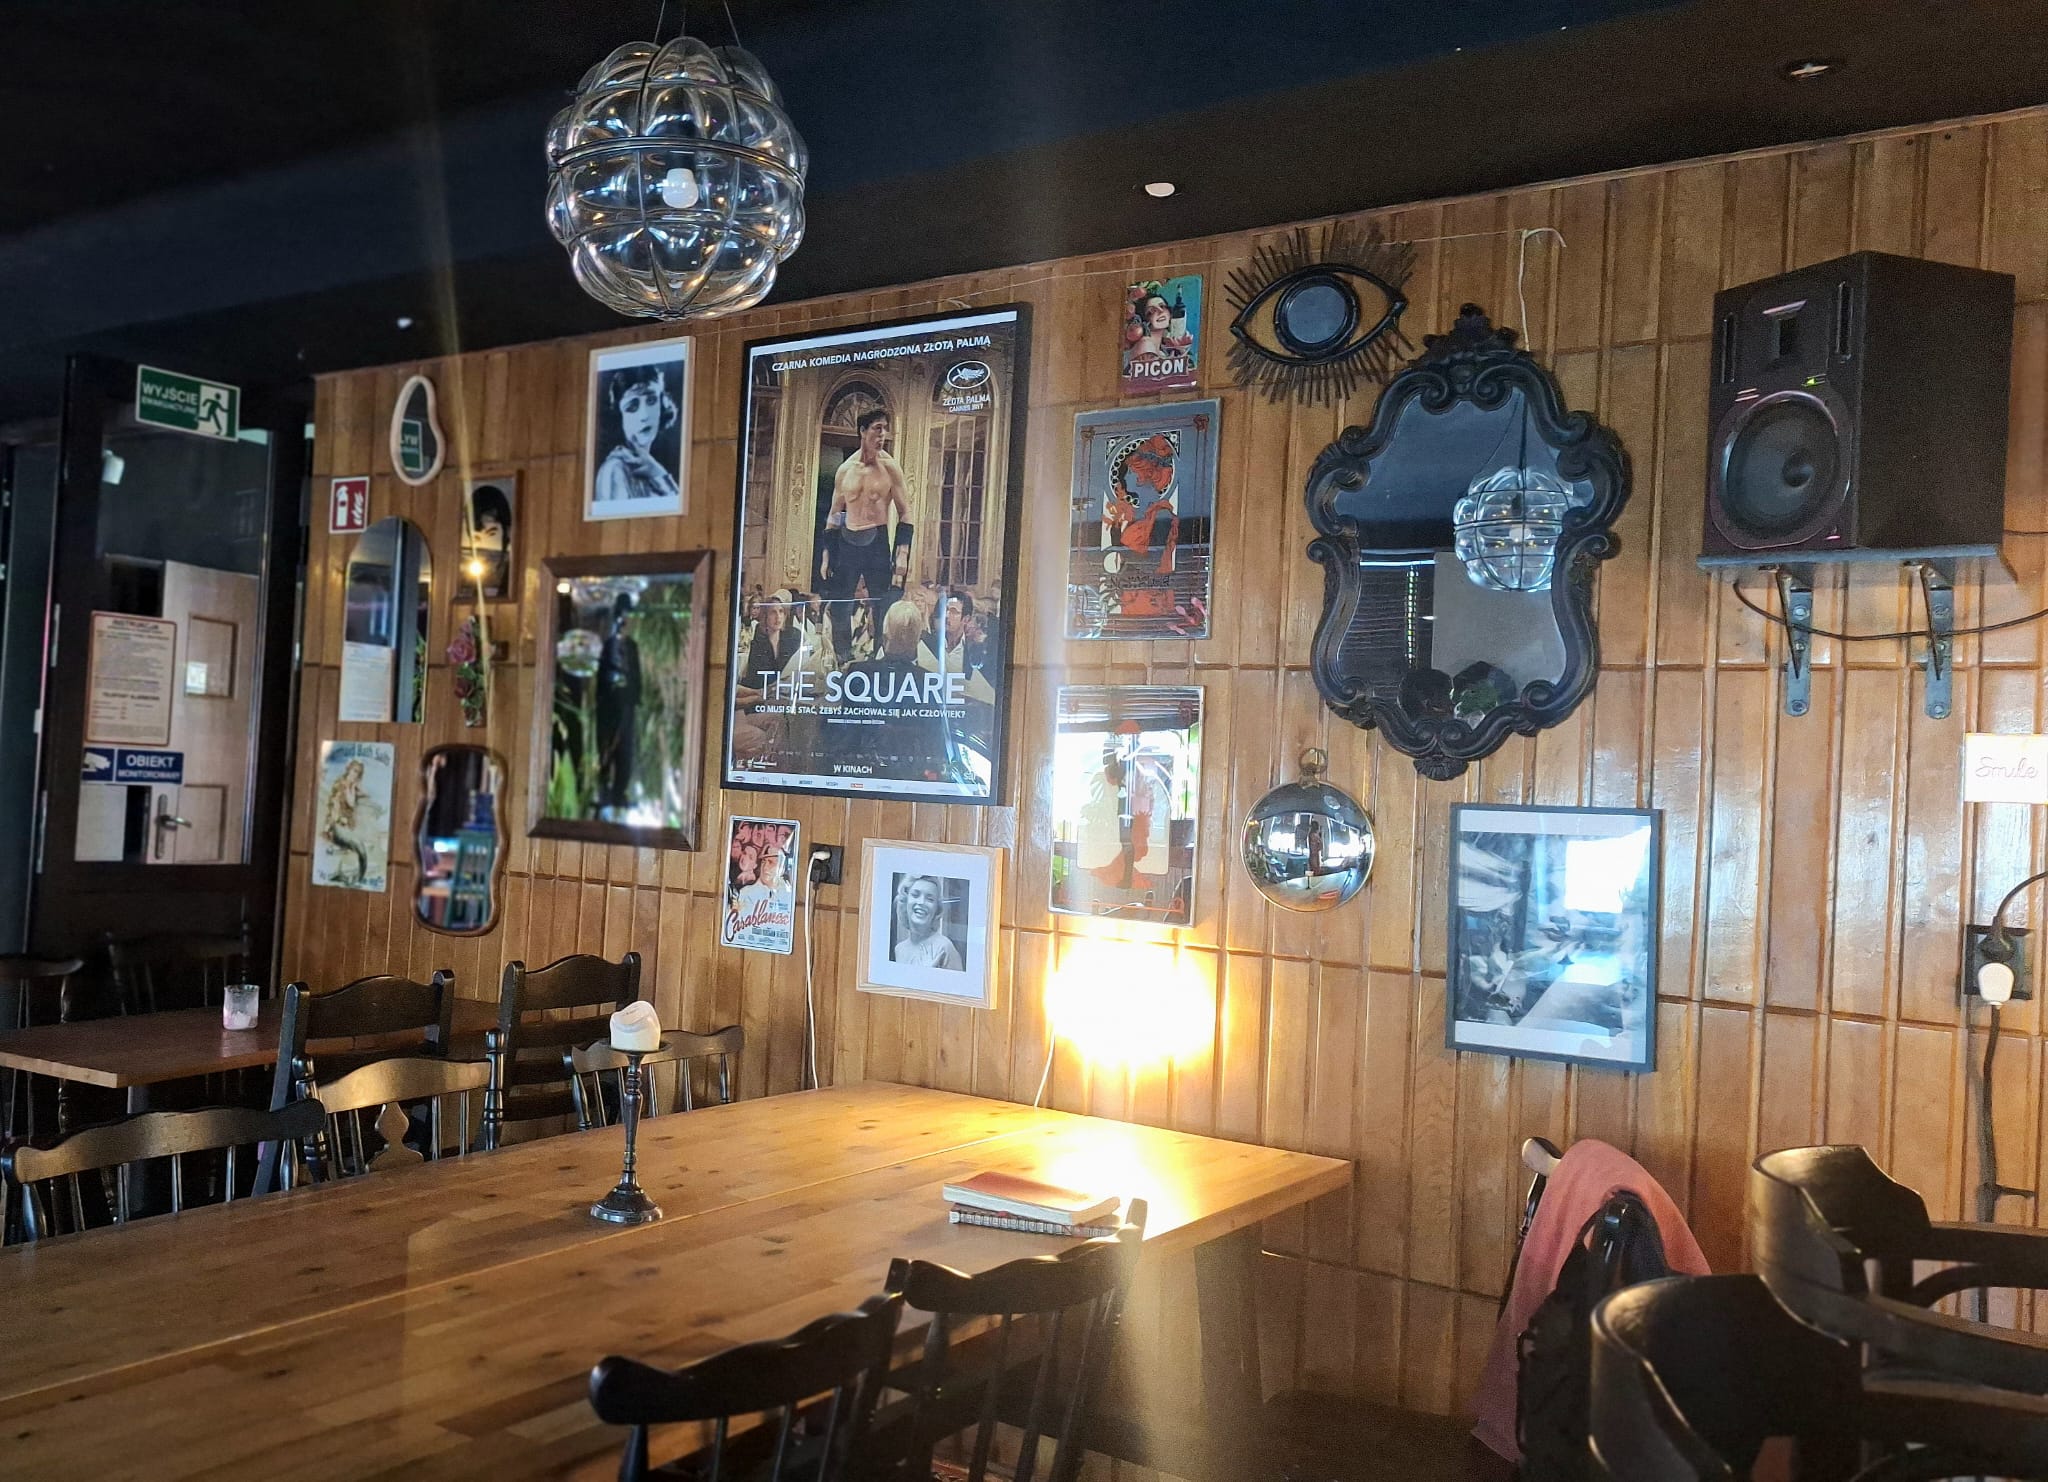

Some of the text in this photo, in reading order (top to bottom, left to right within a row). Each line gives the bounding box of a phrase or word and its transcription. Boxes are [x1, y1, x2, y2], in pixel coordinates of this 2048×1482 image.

[771, 335, 992, 373] CZARNA KOMEDIA NAGRODZONA ZŁOTĄ PALMĄ
[1134, 358, 1184, 378] PICON
[142, 382, 199, 406] WYJŚCIE
[966, 394, 991, 404] PALMA
[757, 670, 966, 705] THE SQUARE
[755, 705, 766, 713] CO
[766, 705, 785, 714] MUSI
[843, 708, 887, 717] ZACHOWAŁ
[888, 709, 900, 718] SIĘ
[901, 709, 917, 717] JAK
[126, 754, 176, 768] OBIEKT
[842, 764, 873, 774] KINACH
[1975, 756, 2041, 779] Smile
[725, 899, 789, 942] Casablanca
